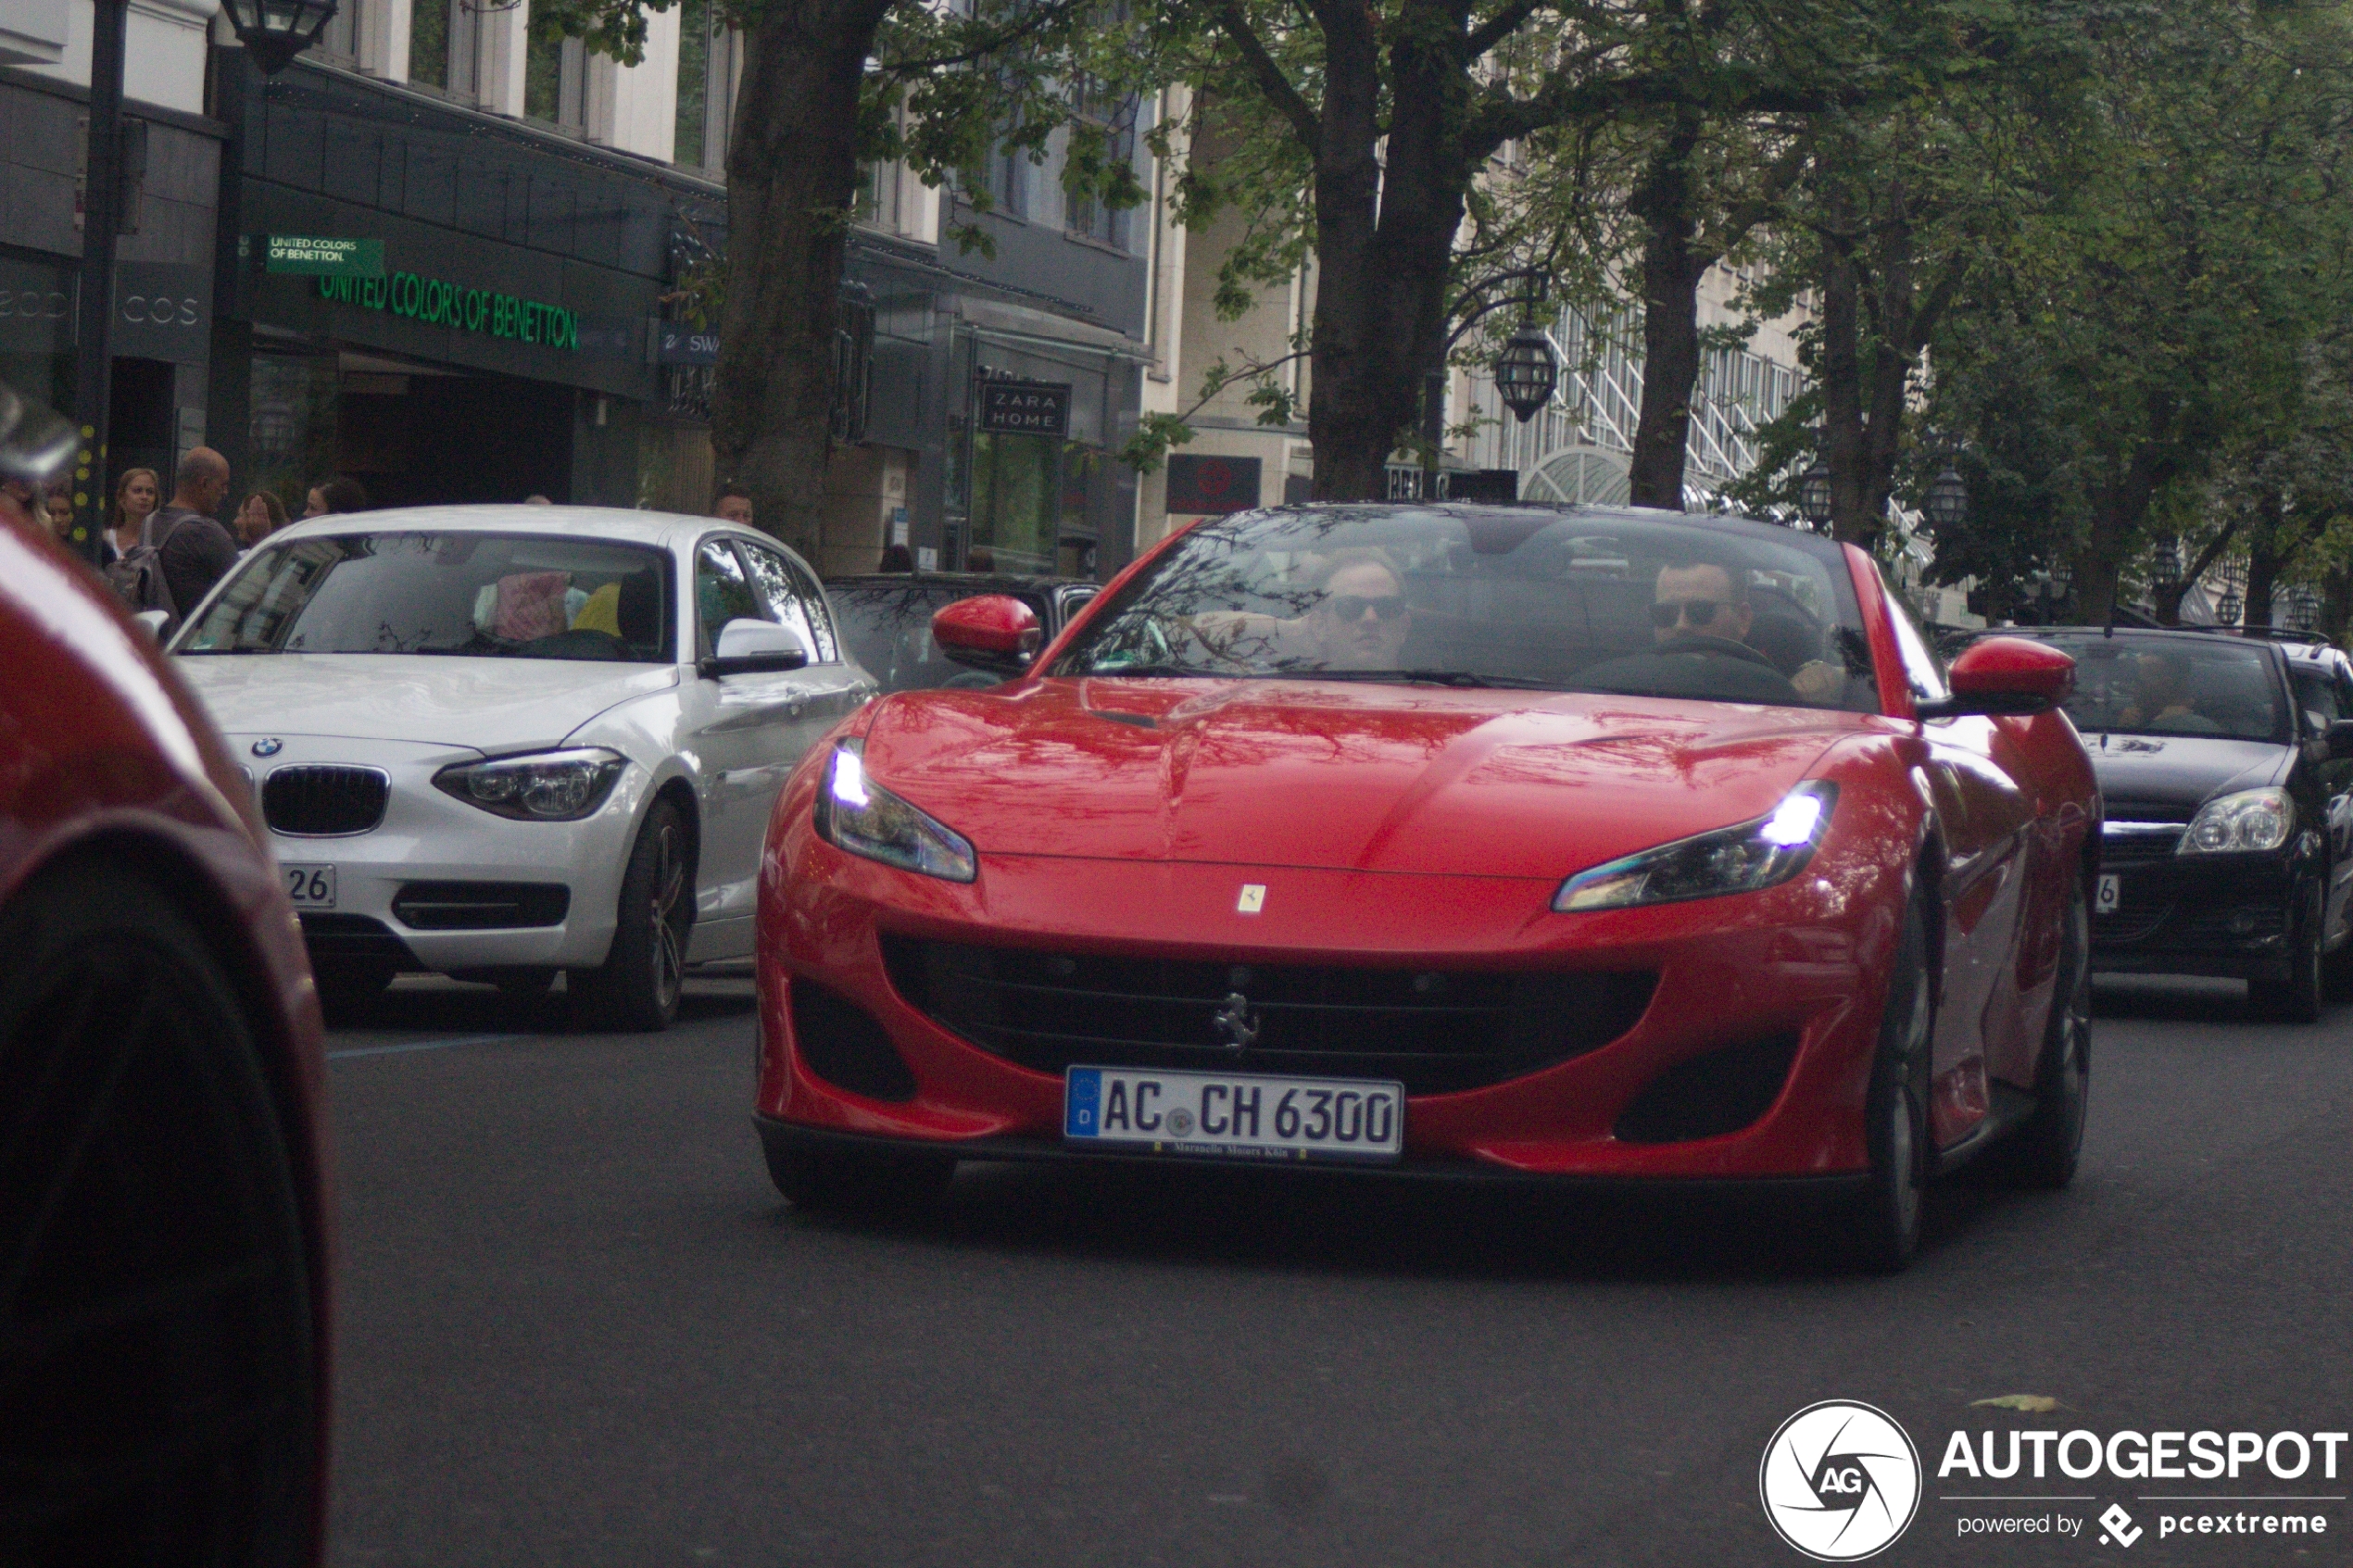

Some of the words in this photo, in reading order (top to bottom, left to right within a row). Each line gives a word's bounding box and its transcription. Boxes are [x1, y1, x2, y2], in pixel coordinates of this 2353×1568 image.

[270, 248, 285, 258] OF
[271, 236, 311, 248] UNITED
[312, 239, 357, 251] COLORS
[123, 295, 198, 326] COS
[392, 270, 462, 328] COLORS
[466, 288, 490, 332] OF
[995, 393, 1056, 408] ZARA
[992, 412, 1055, 427] HOME
[289, 869, 328, 900] 26
[2101, 879, 2115, 903] 6
[1104, 1079, 1162, 1131] AC
[1200, 1084, 1261, 1136] CH
[1275, 1087, 1393, 1143] 6300
[1174, 1142, 1223, 1154] Maranello
[1227, 1145, 1261, 1156] Motors
[1265, 1147, 1289, 1158] Köln
